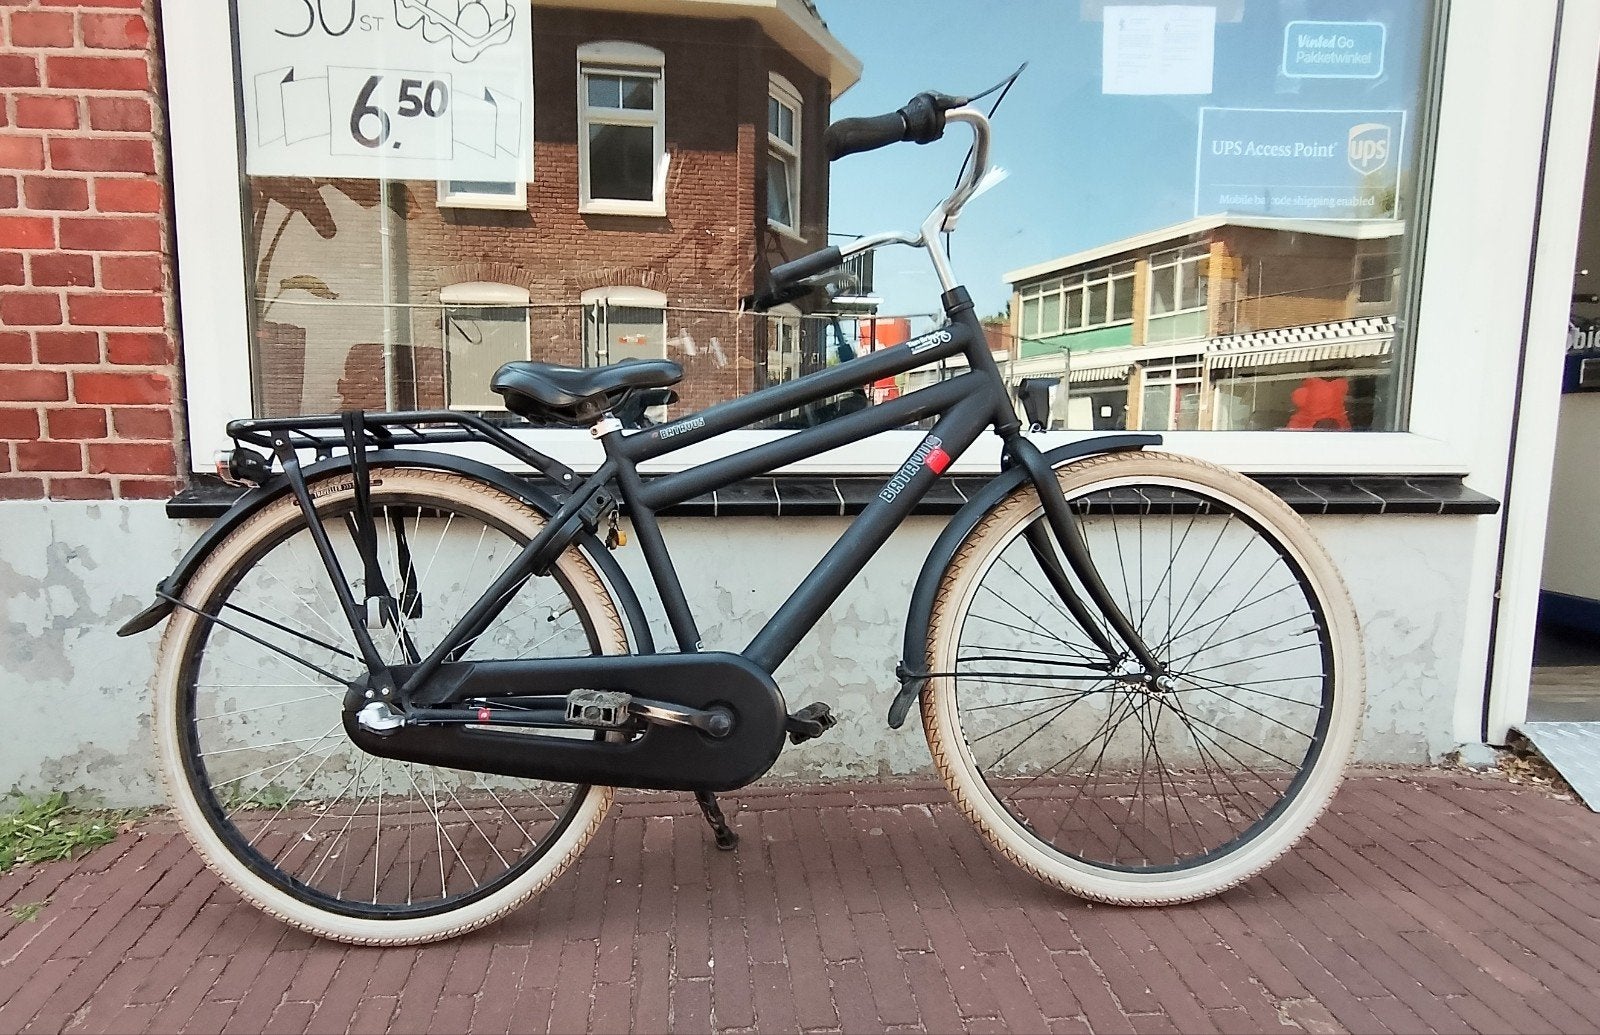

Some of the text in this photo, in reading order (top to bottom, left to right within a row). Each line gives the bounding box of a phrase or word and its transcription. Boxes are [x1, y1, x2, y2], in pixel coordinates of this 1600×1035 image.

[360, 15, 384, 31] ST
[1298, 34, 1354, 49] Vinted Go
[1296, 50, 1372, 64] Pakketwinkel
[1212, 140, 1335, 158] UPS Access Point
[1350, 139, 1387, 167] ups
[1219, 194, 1375, 209] Mobile bacode shipping enabled
